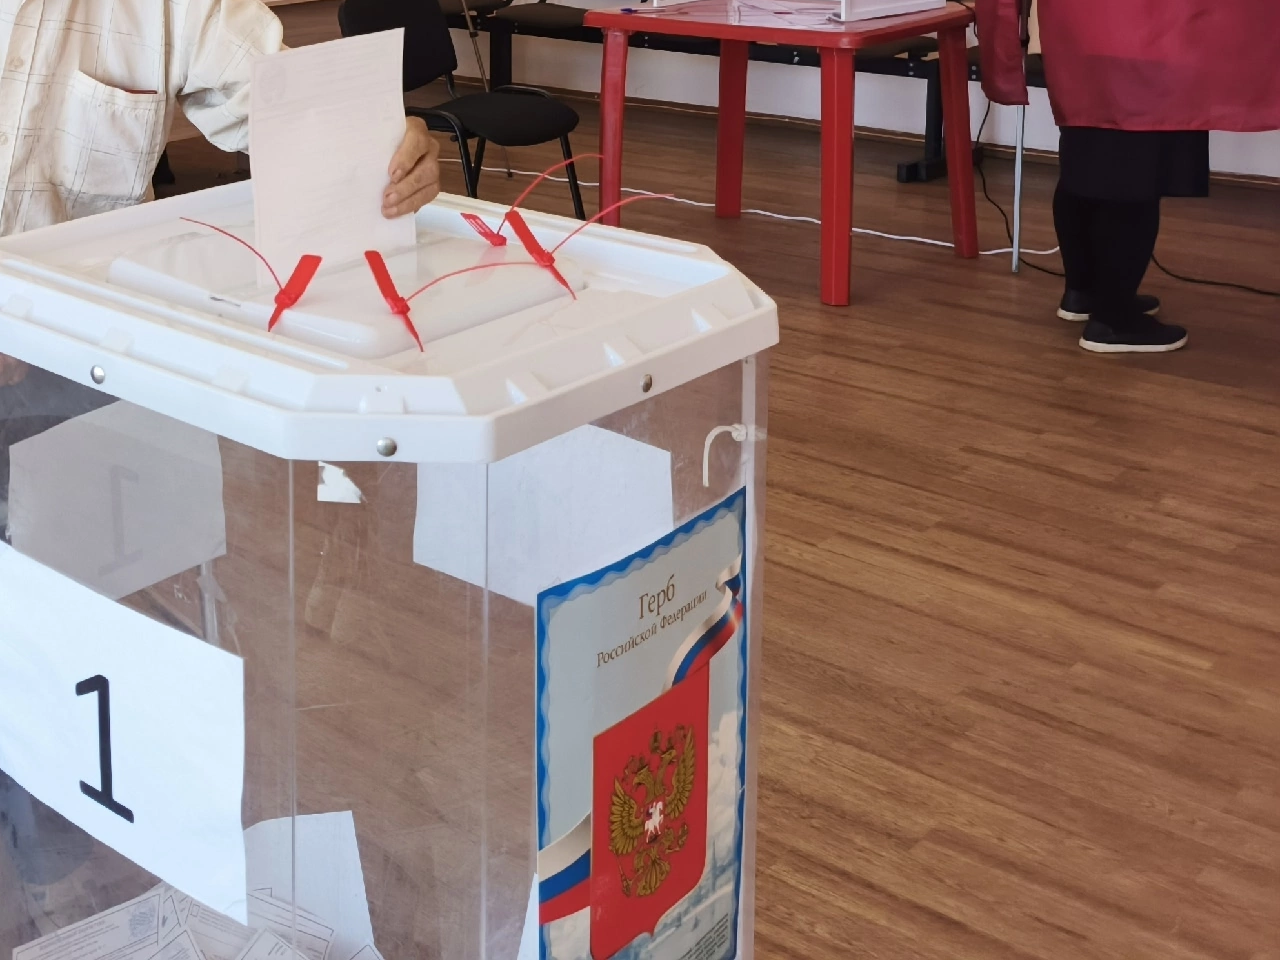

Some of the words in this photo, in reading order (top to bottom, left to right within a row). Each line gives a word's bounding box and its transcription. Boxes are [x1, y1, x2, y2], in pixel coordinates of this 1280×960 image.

[597, 623, 657, 668] Российской
[660, 589, 707, 629] Федерации
[639, 574, 675, 620] Герб
[75, 674, 135, 824] 1
